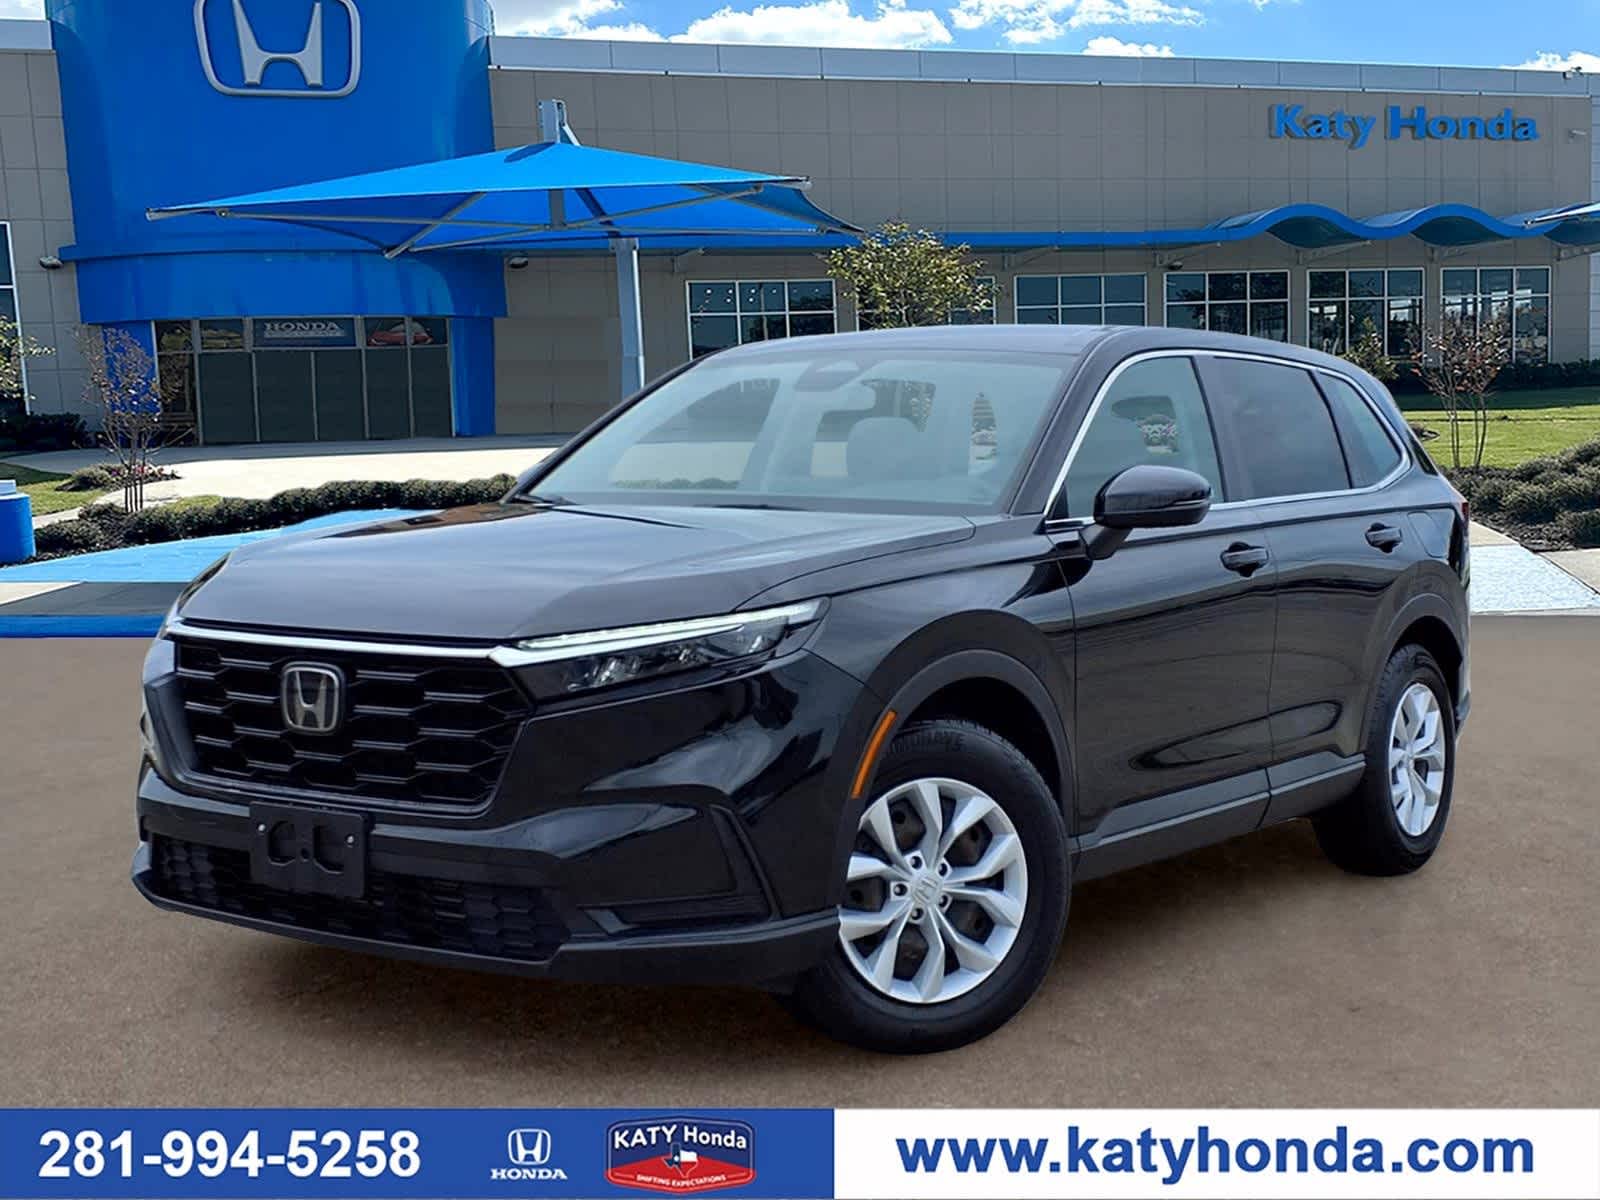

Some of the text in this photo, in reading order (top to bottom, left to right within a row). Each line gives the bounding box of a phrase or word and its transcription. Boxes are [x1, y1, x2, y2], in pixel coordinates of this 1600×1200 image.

[1271, 104, 1539, 149] Katy Honda
[264, 321, 341, 331] HONDA
